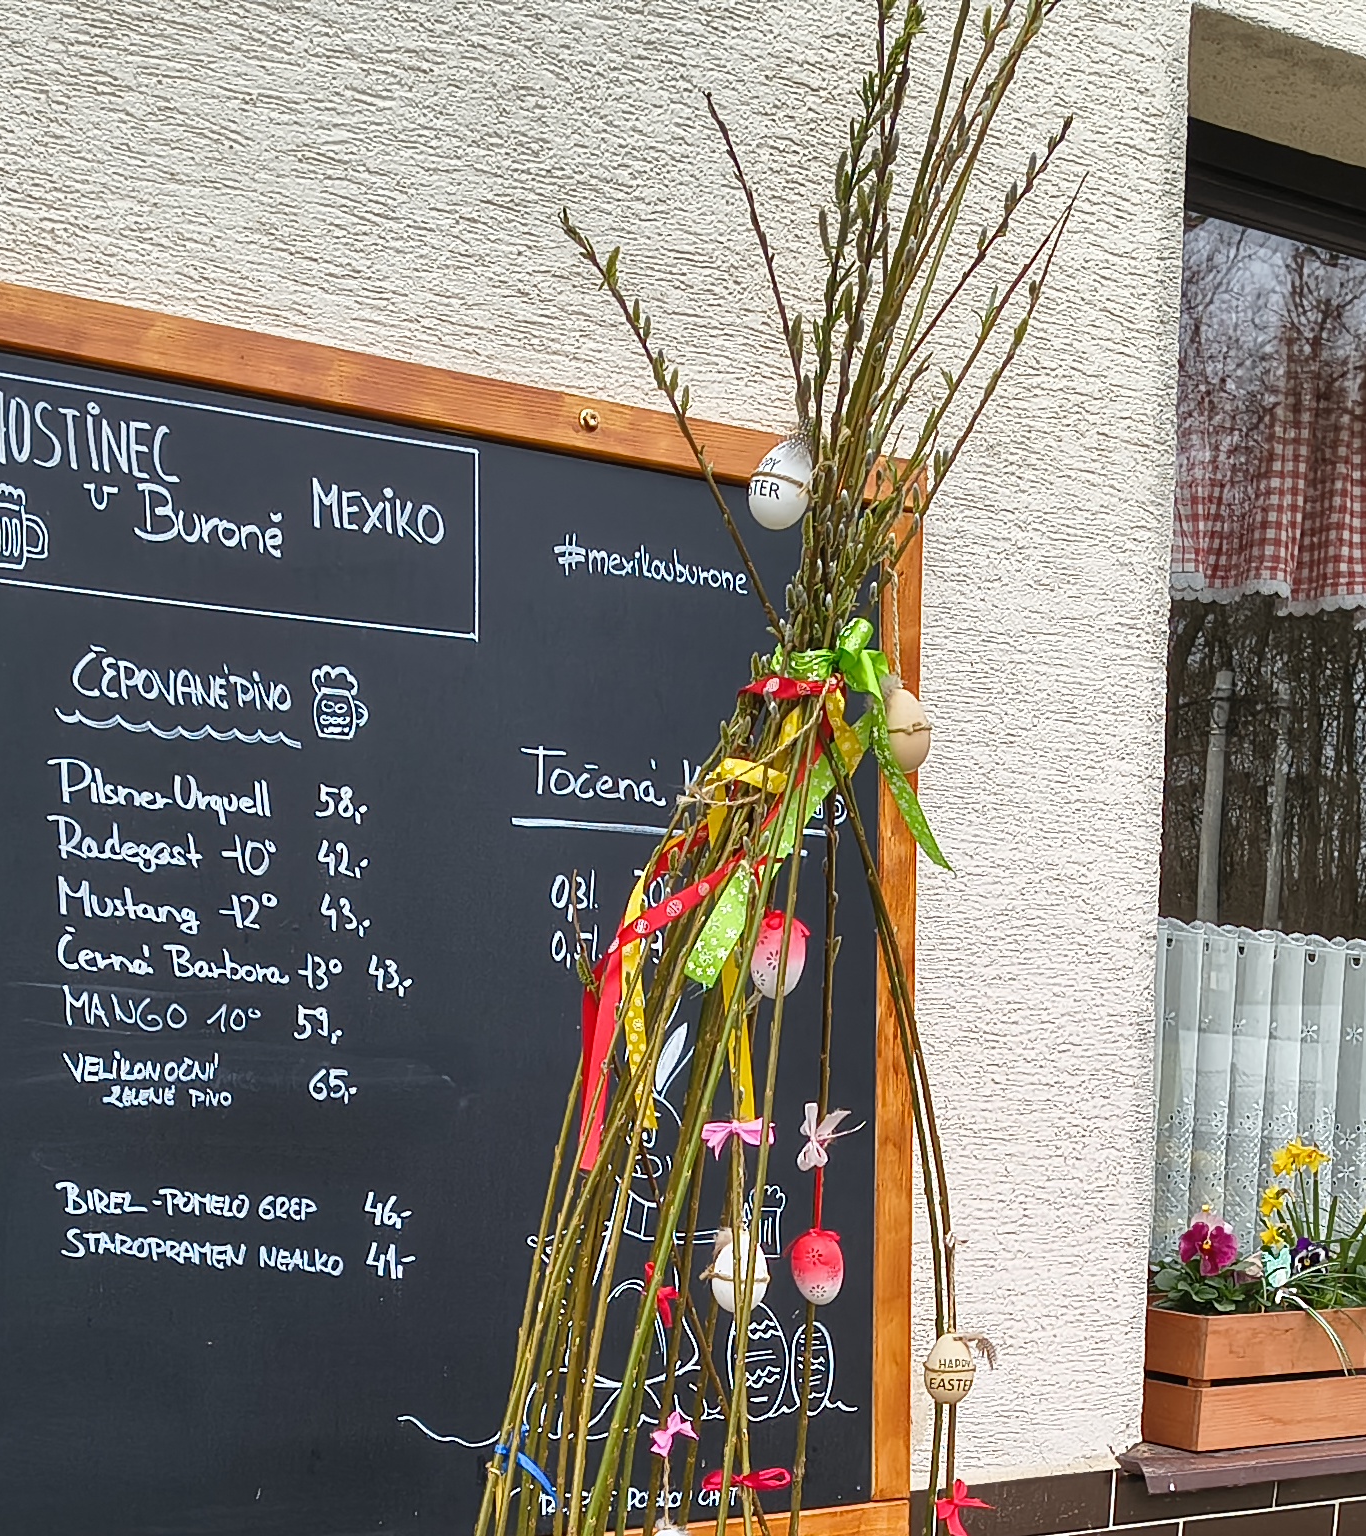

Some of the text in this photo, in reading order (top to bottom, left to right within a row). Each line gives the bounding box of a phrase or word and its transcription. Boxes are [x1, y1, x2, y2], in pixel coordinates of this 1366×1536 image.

[134, 481, 284, 559] Buroně
[312, 478, 446, 547] MEXIKO
[72, 645, 292, 712] ČEPOVANÉ PIVO
[47, 757, 173, 806] Pilsner
[174, 774, 273, 826] Urquell
[520, 745, 667, 807] Točená
[47, 815, 203, 873] Radegast
[57, 876, 201, 935] Mustang
[56, 926, 155, 976] Černá
[163, 944, 290, 986] Barbora
[62, 985, 188, 1033] MANGO
[62, 1051, 358, 1105] VELIKONOČNÍ 65,-
[190, 1086, 232, 1107] PIVO
[258, 1195, 318, 1221] GREP
[363, 1192, 413, 1229] 46,-
[61, 1228, 247, 1267] STAROPRAMEN
[259, 1248, 344, 1277] NEALKO
